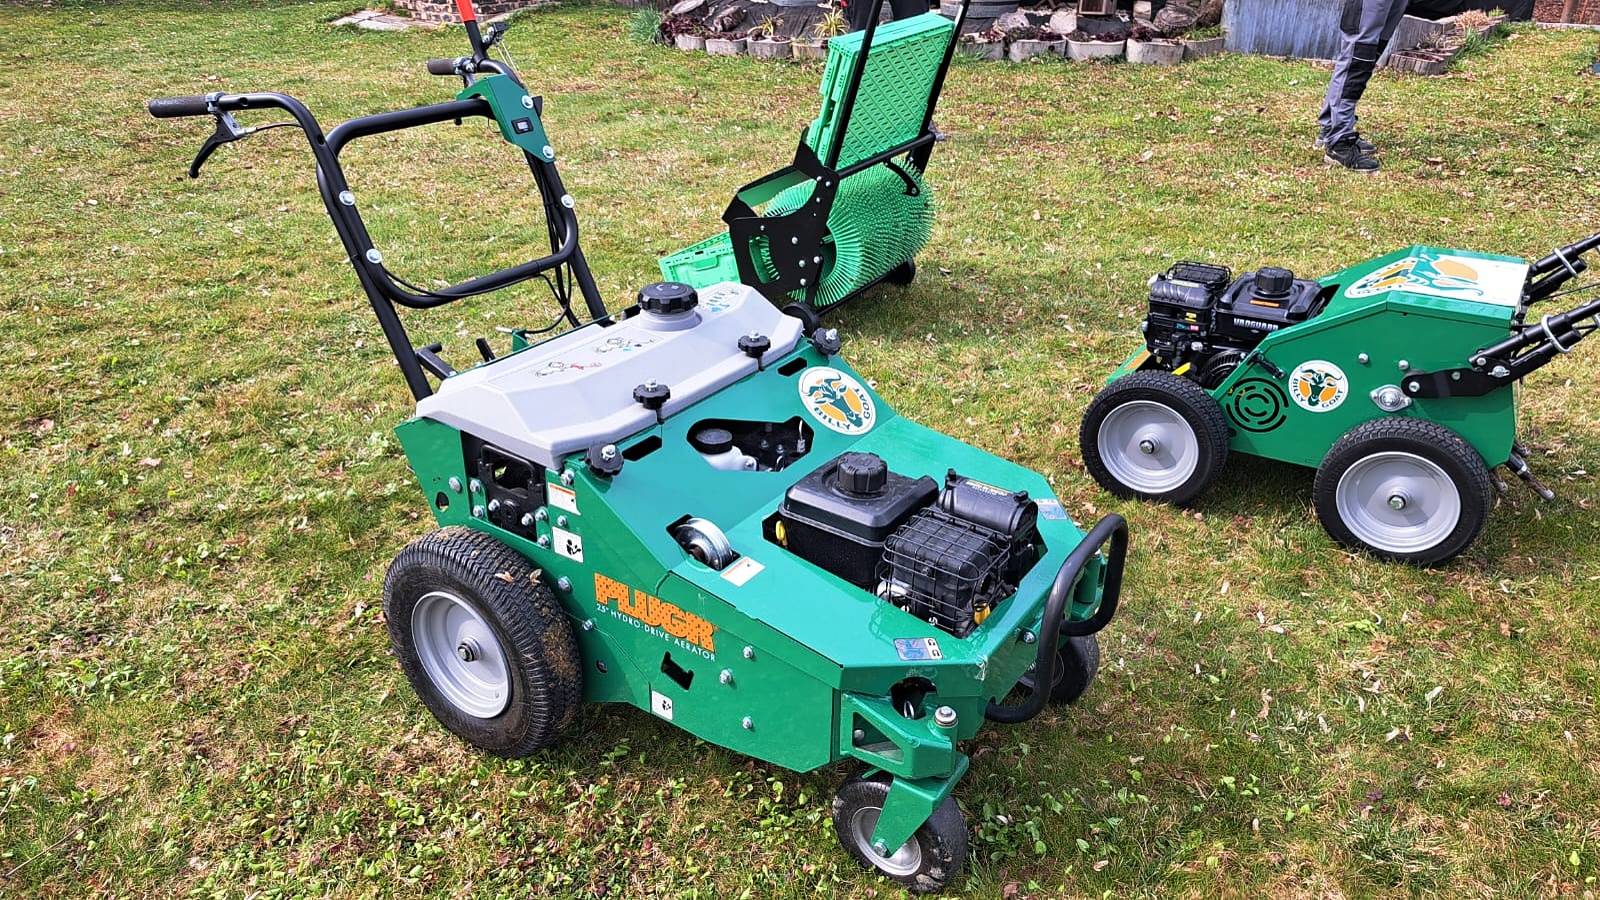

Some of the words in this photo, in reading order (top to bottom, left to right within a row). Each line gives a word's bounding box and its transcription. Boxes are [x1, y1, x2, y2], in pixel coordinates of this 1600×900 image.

[1233, 318, 1279, 331] VANGUARD
[1293, 378, 1306, 402] BILLY
[1321, 389, 1343, 408] GOAT
[814, 407, 851, 430] BILLY
[854, 387, 871, 419] GOAT
[674, 639, 716, 661] AERATOR
